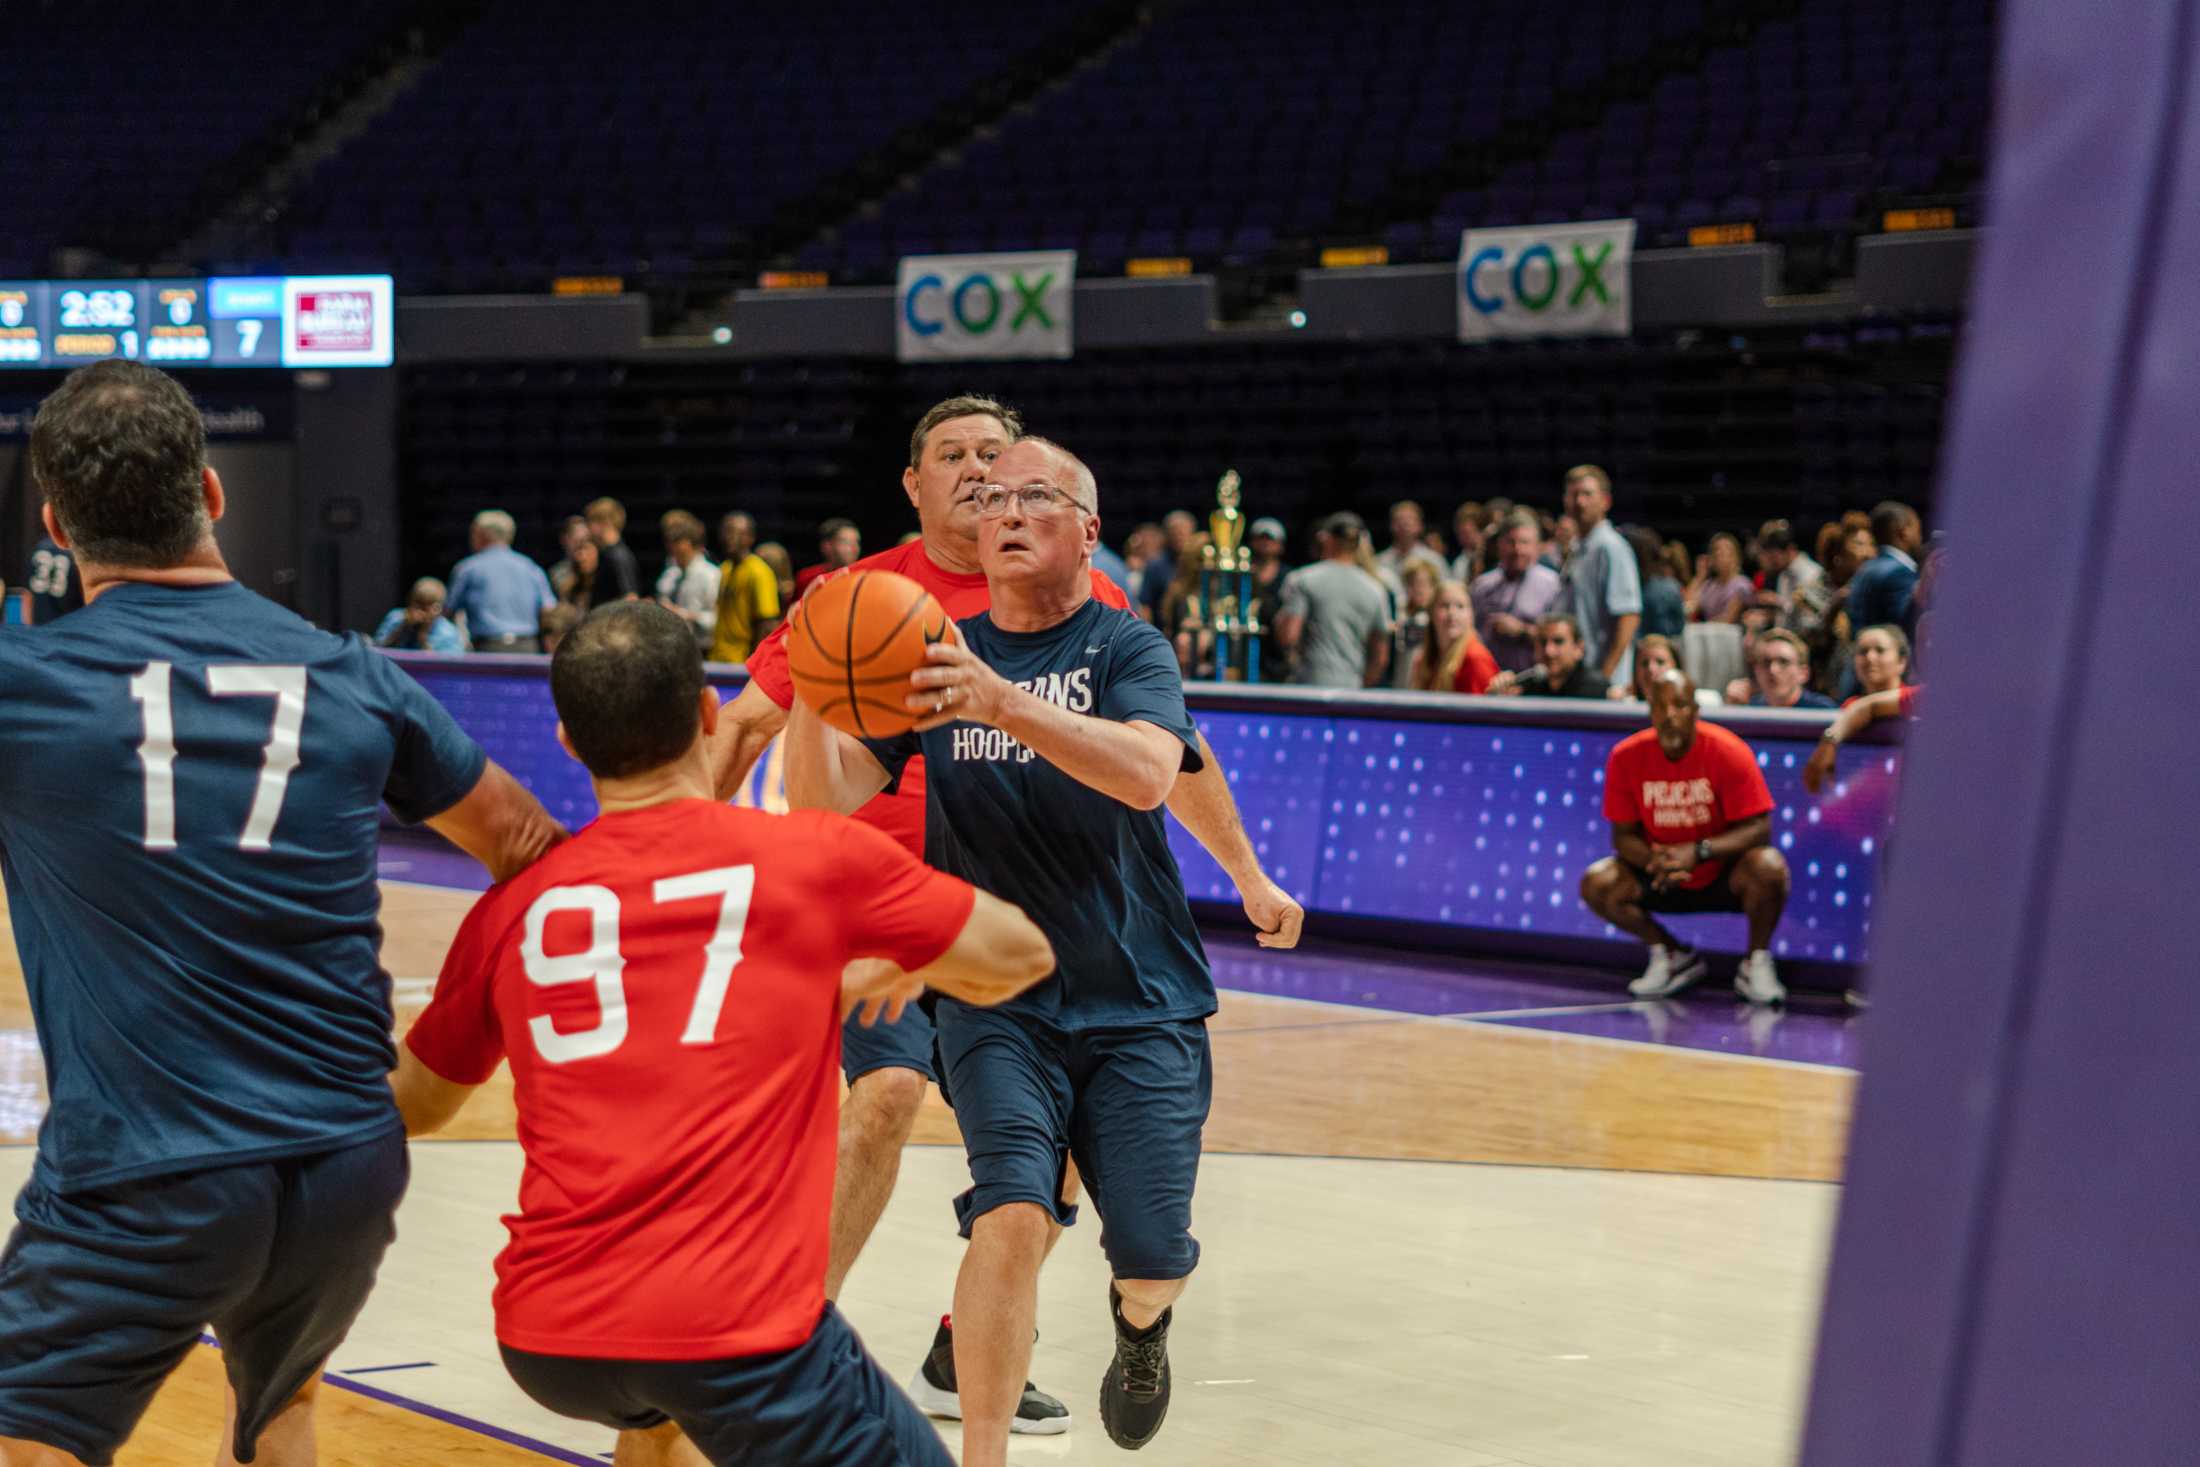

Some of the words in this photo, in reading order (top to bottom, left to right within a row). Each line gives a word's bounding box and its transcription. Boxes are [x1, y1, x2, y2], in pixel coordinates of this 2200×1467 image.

[905, 273, 1056, 336] COX
[1466, 241, 1616, 314] COX
[235, 319, 263, 358] 7
[130, 661, 308, 852] 17
[520, 863, 756, 1066] 97
